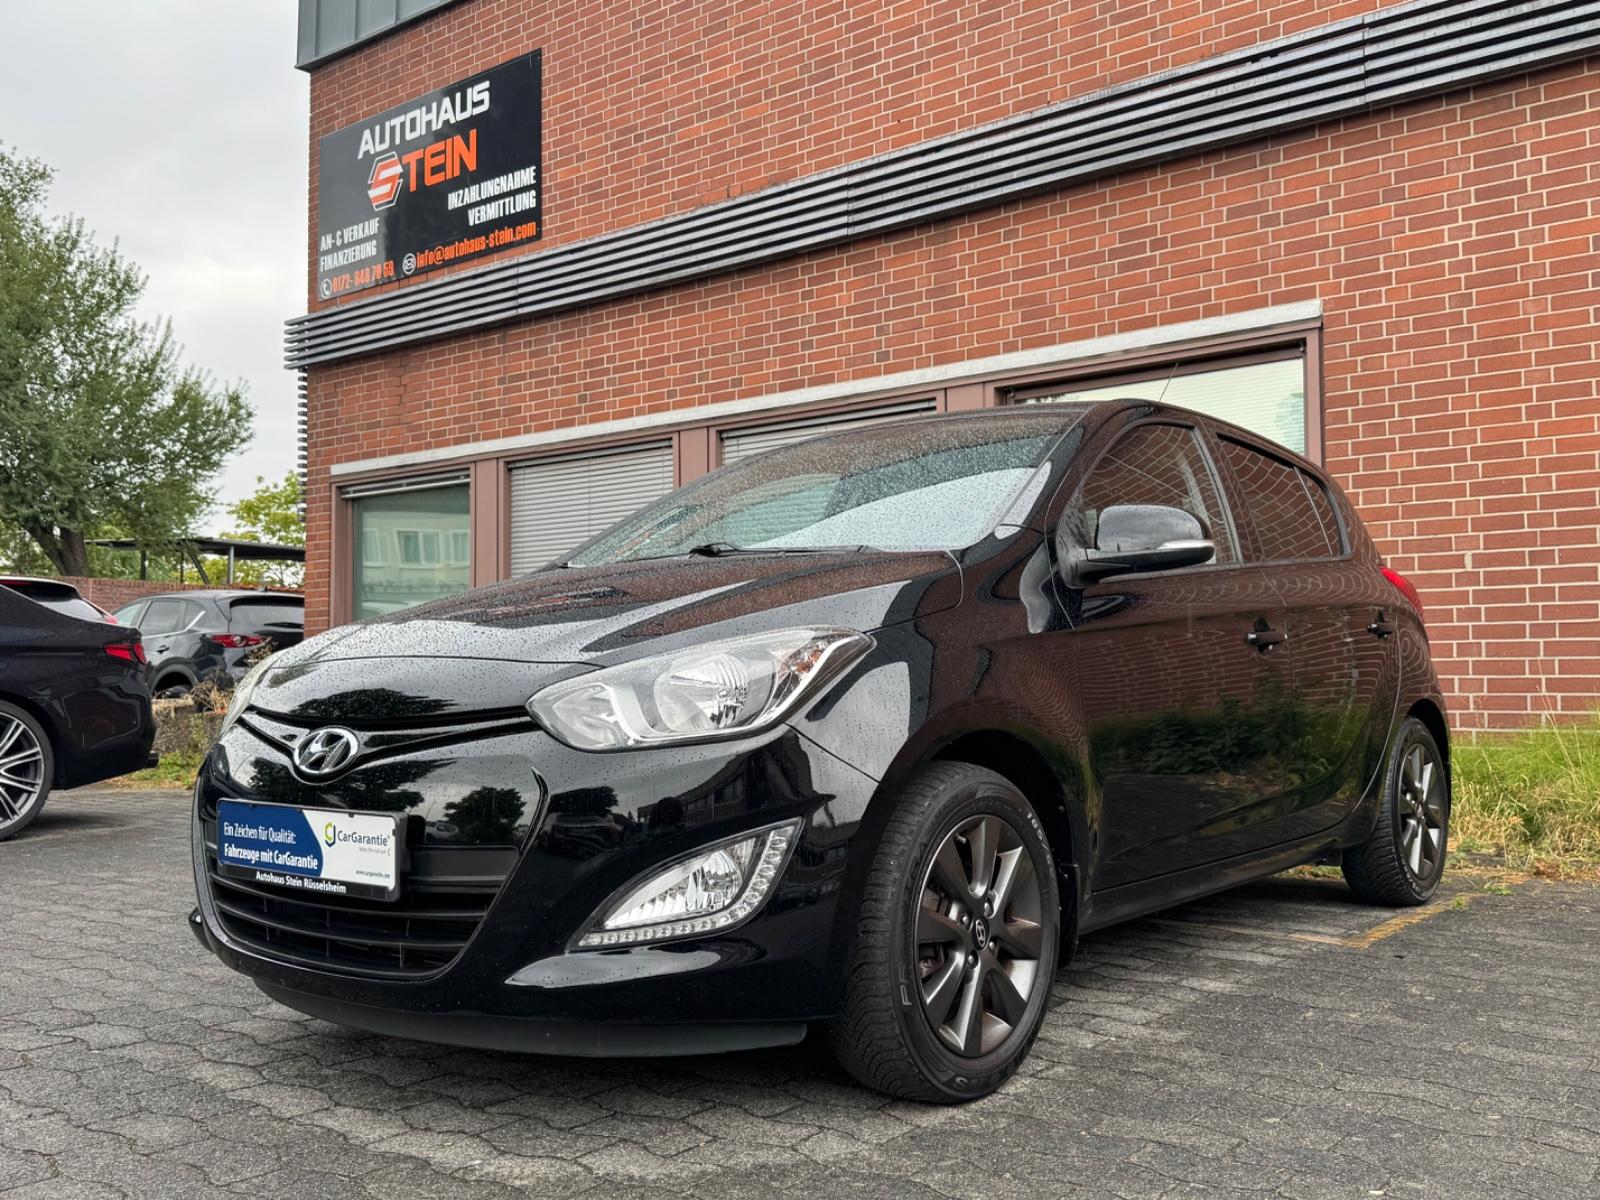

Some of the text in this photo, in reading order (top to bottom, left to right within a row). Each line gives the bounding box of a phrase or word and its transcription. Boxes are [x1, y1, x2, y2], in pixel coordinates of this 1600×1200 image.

[357, 80, 490, 160] AUTOHAUS
[368, 128, 477, 206] STEIN
[447, 166, 536, 210] INZAHLUNGNAHME
[468, 190, 536, 226] VERMITTLUNG
[343, 217, 380, 243] VERKAUF
[416, 222, 536, 268] info@autohaus-stein.com
[320, 239, 377, 272] FINANZIERUNG
[223, 821, 296, 844] Ein Zeichen für Qualität:
[224, 843, 318, 869] Fahrzeuge mit CarGarantie
[256, 870, 346, 894] Autohaus Stein Rüsselsheim
